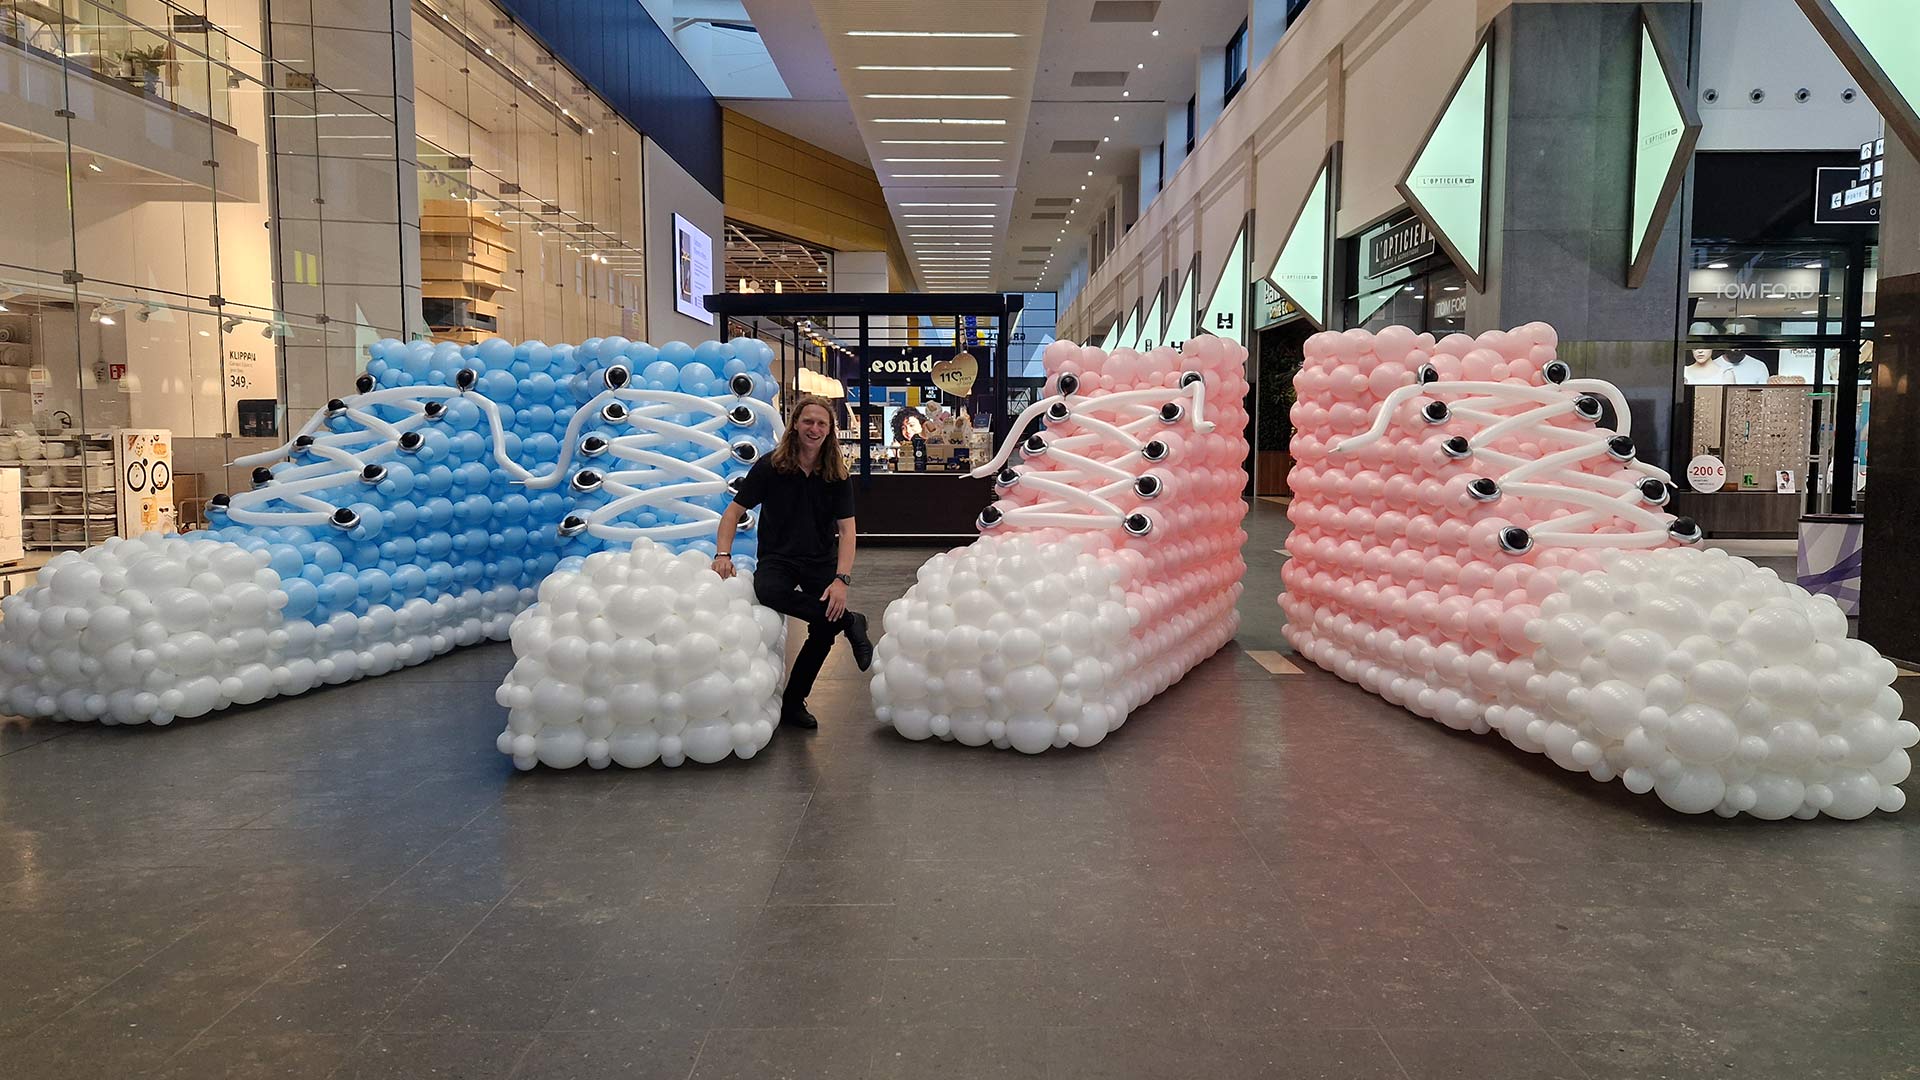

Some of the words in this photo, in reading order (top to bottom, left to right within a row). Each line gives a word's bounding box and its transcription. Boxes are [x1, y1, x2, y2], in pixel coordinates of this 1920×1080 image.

[1375, 222, 1427, 263] L'OPTICIEN
[1714, 283, 1757, 300] TOM
[1760, 283, 1815, 300] FORD
[1689, 466, 1713, 476] -200
[1717, 466, 1724, 476] €
